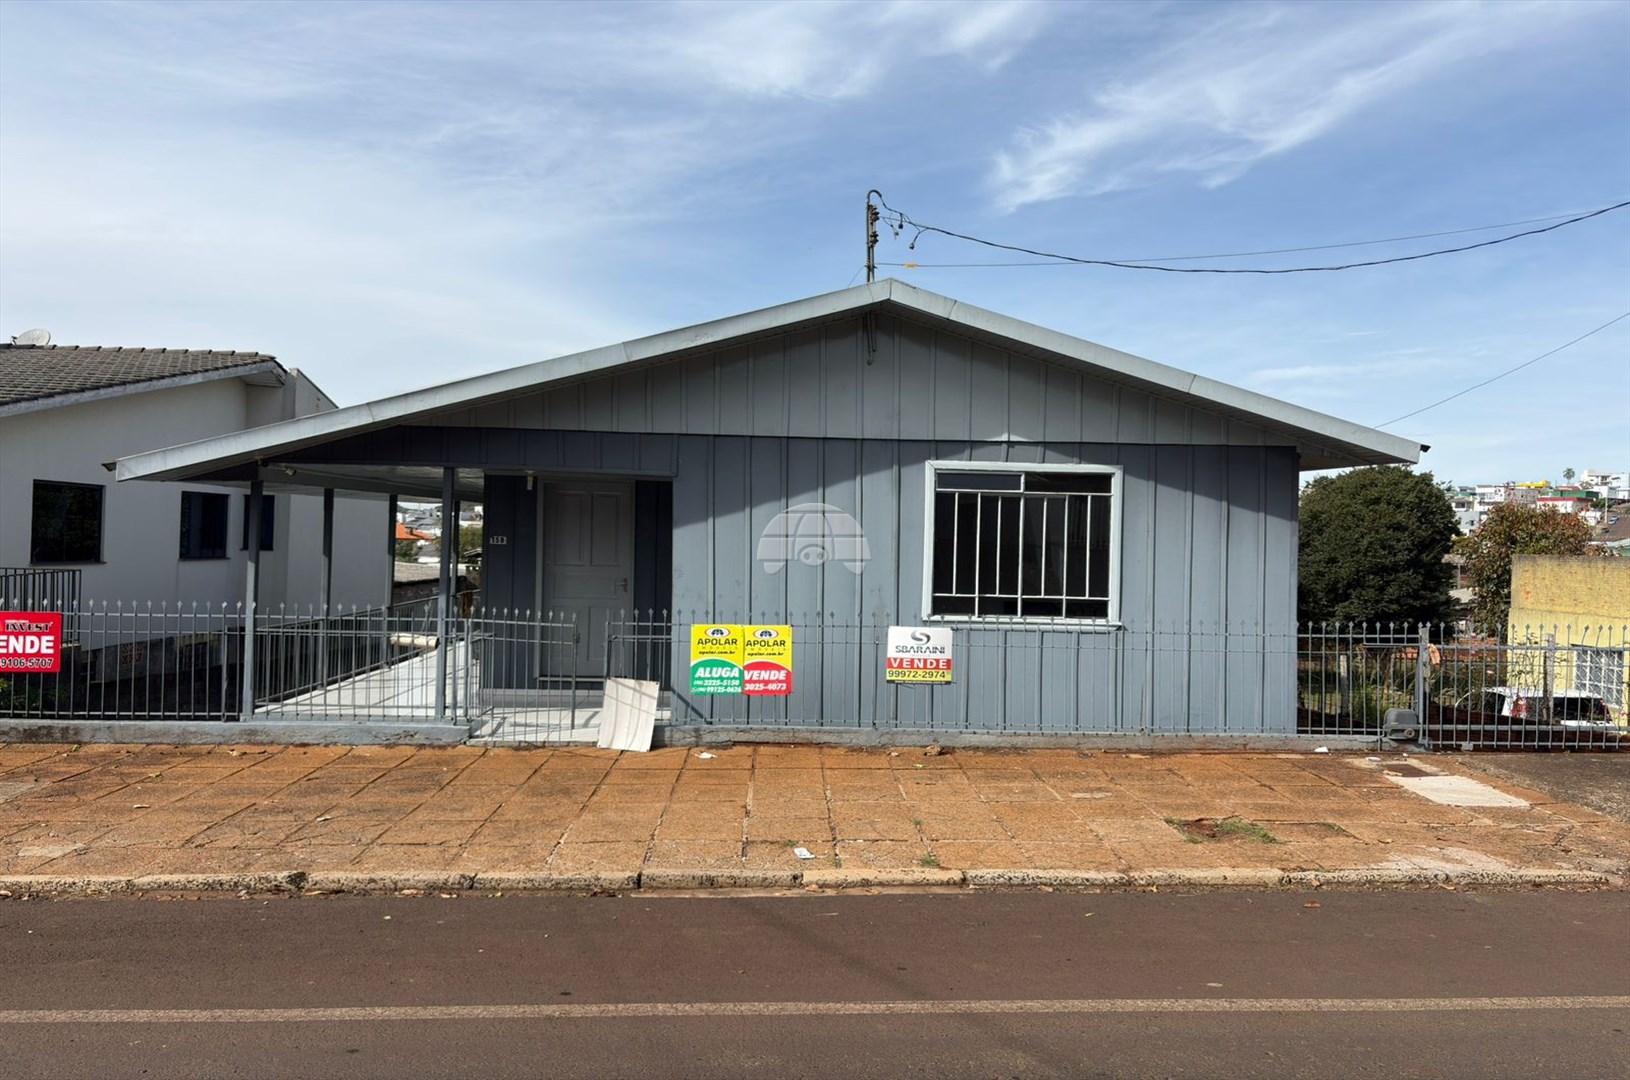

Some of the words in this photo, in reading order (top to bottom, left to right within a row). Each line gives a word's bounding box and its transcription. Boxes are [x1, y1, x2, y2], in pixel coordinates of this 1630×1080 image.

[890, 658, 947, 669] VENDE
[695, 667, 740, 678] ALUGA
[744, 670, 787, 680] VENDE
[888, 670, 946, 678] 99972-2974
[744, 683, 787, 691] 3025-4073
